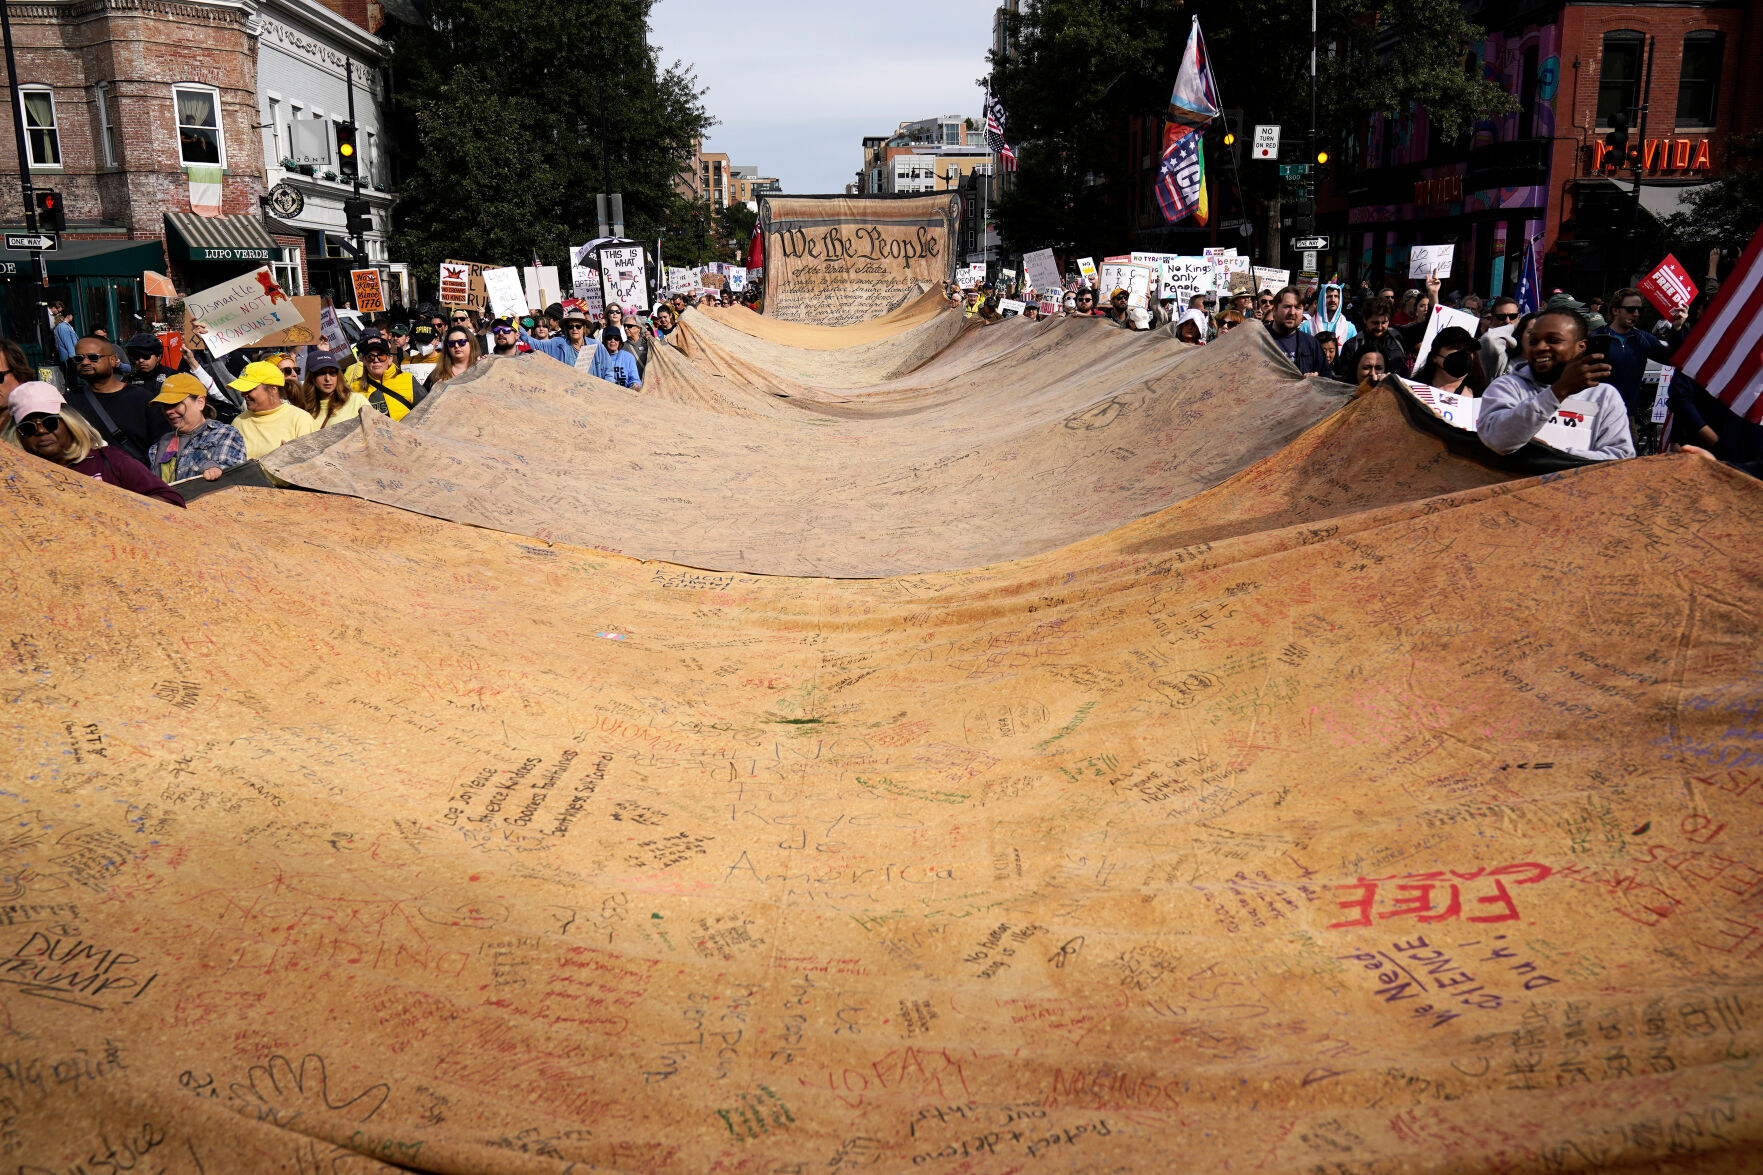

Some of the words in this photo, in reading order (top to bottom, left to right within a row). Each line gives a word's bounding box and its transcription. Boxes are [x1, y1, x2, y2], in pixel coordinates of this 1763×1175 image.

[1643, 139, 1711, 169] VIDA
[771, 224, 822, 258] We
[856, 226, 940, 268] People
[205, 250, 231, 258] LUPO
[234, 250, 269, 258] VERDE
[604, 250, 623, 259] THIS
[630, 249, 638, 257] IS
[1412, 249, 1428, 260] NO
[615, 258, 635, 267] WHAT
[1168, 264, 1181, 273] No
[1186, 264, 1212, 275] Kings
[356, 282, 379, 291] Kings
[1652, 271, 1674, 296] FREE
[358, 290, 380, 299] Since
[189, 285, 256, 320] Dismantle
[240, 295, 266, 314] NOT
[361, 300, 381, 309] 1776
[16, 932, 140, 975] DUMP
[962, 951, 988, 965] No
[1336, 953, 1420, 1003] Need
